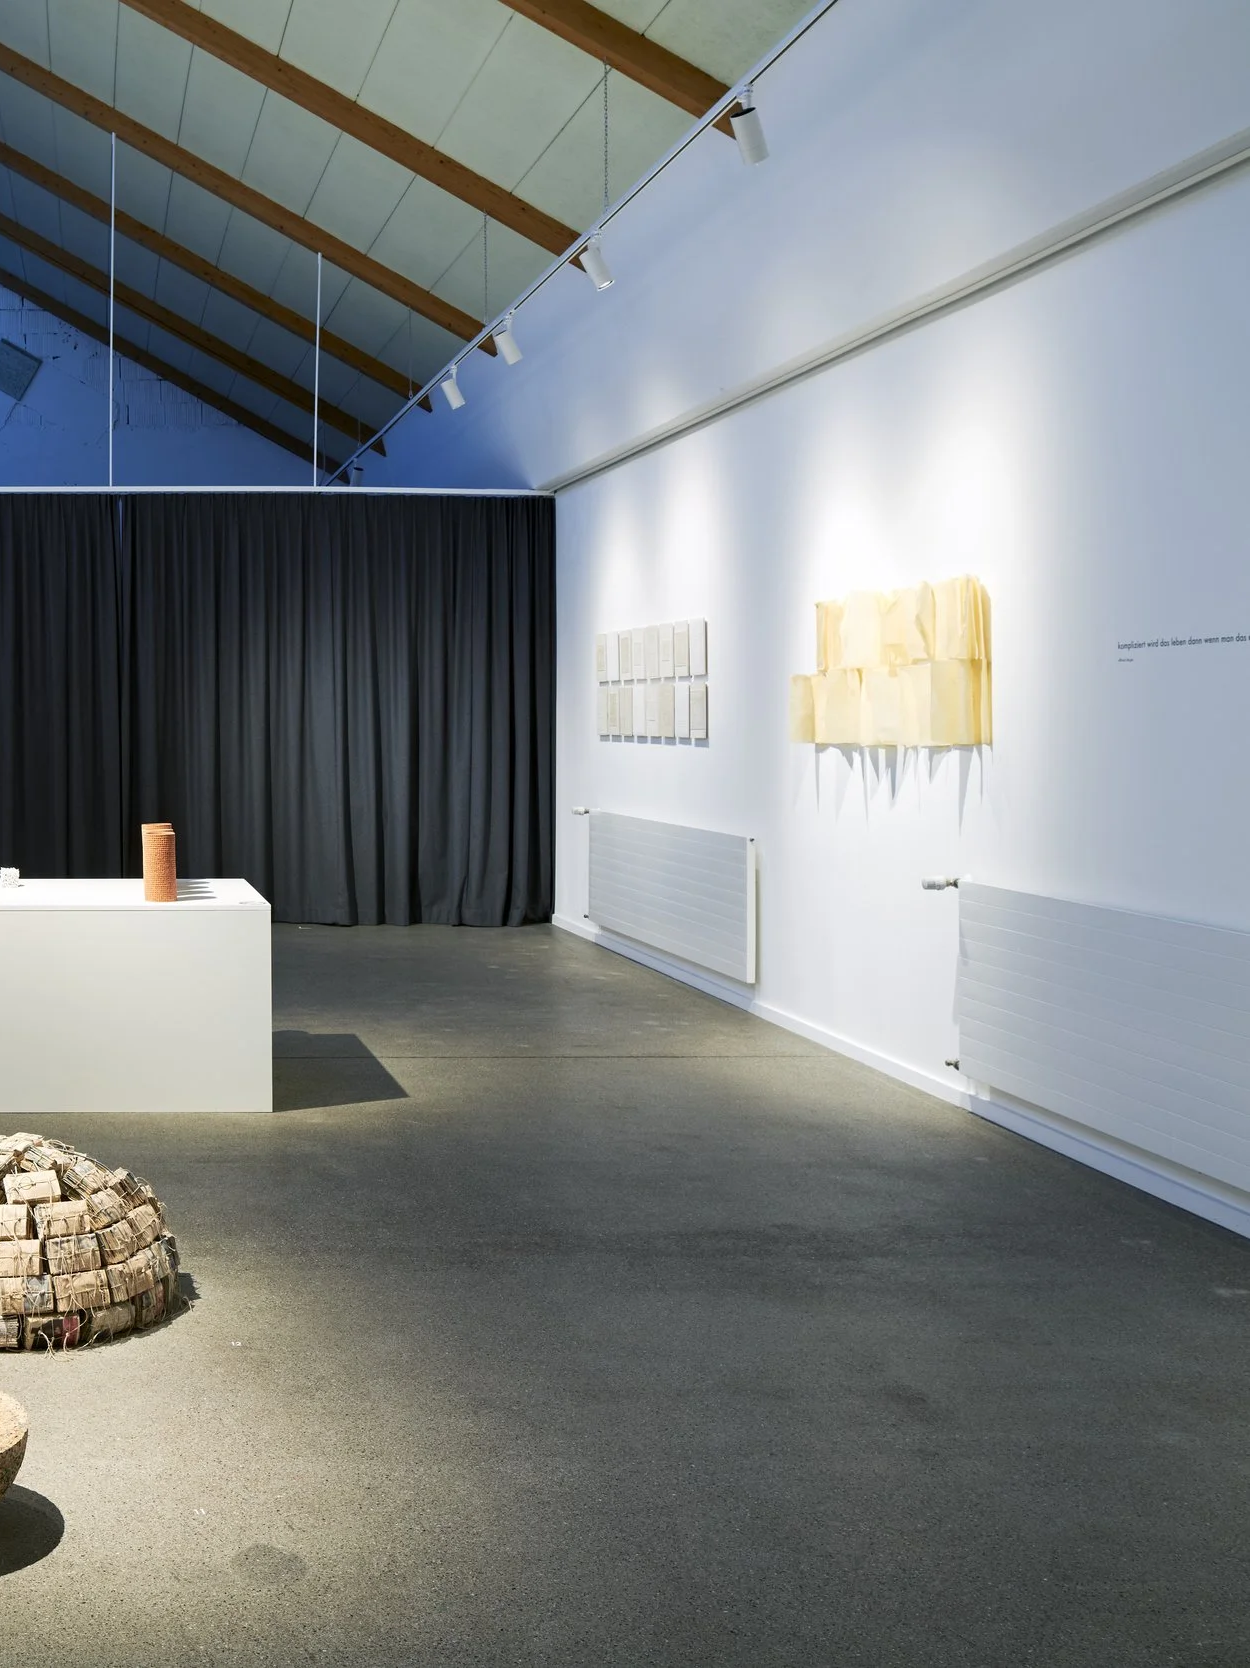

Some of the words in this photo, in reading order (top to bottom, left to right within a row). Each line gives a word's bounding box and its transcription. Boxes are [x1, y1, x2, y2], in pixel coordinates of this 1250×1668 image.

[1118, 641, 1145, 651] kompliziert
[1147, 639, 1158, 648] wird
[1160, 638, 1169, 647] das
[1171, 637, 1186, 646] leben
[1188, 636, 1202, 645] dann
[1236, 633, 1246, 642] das
